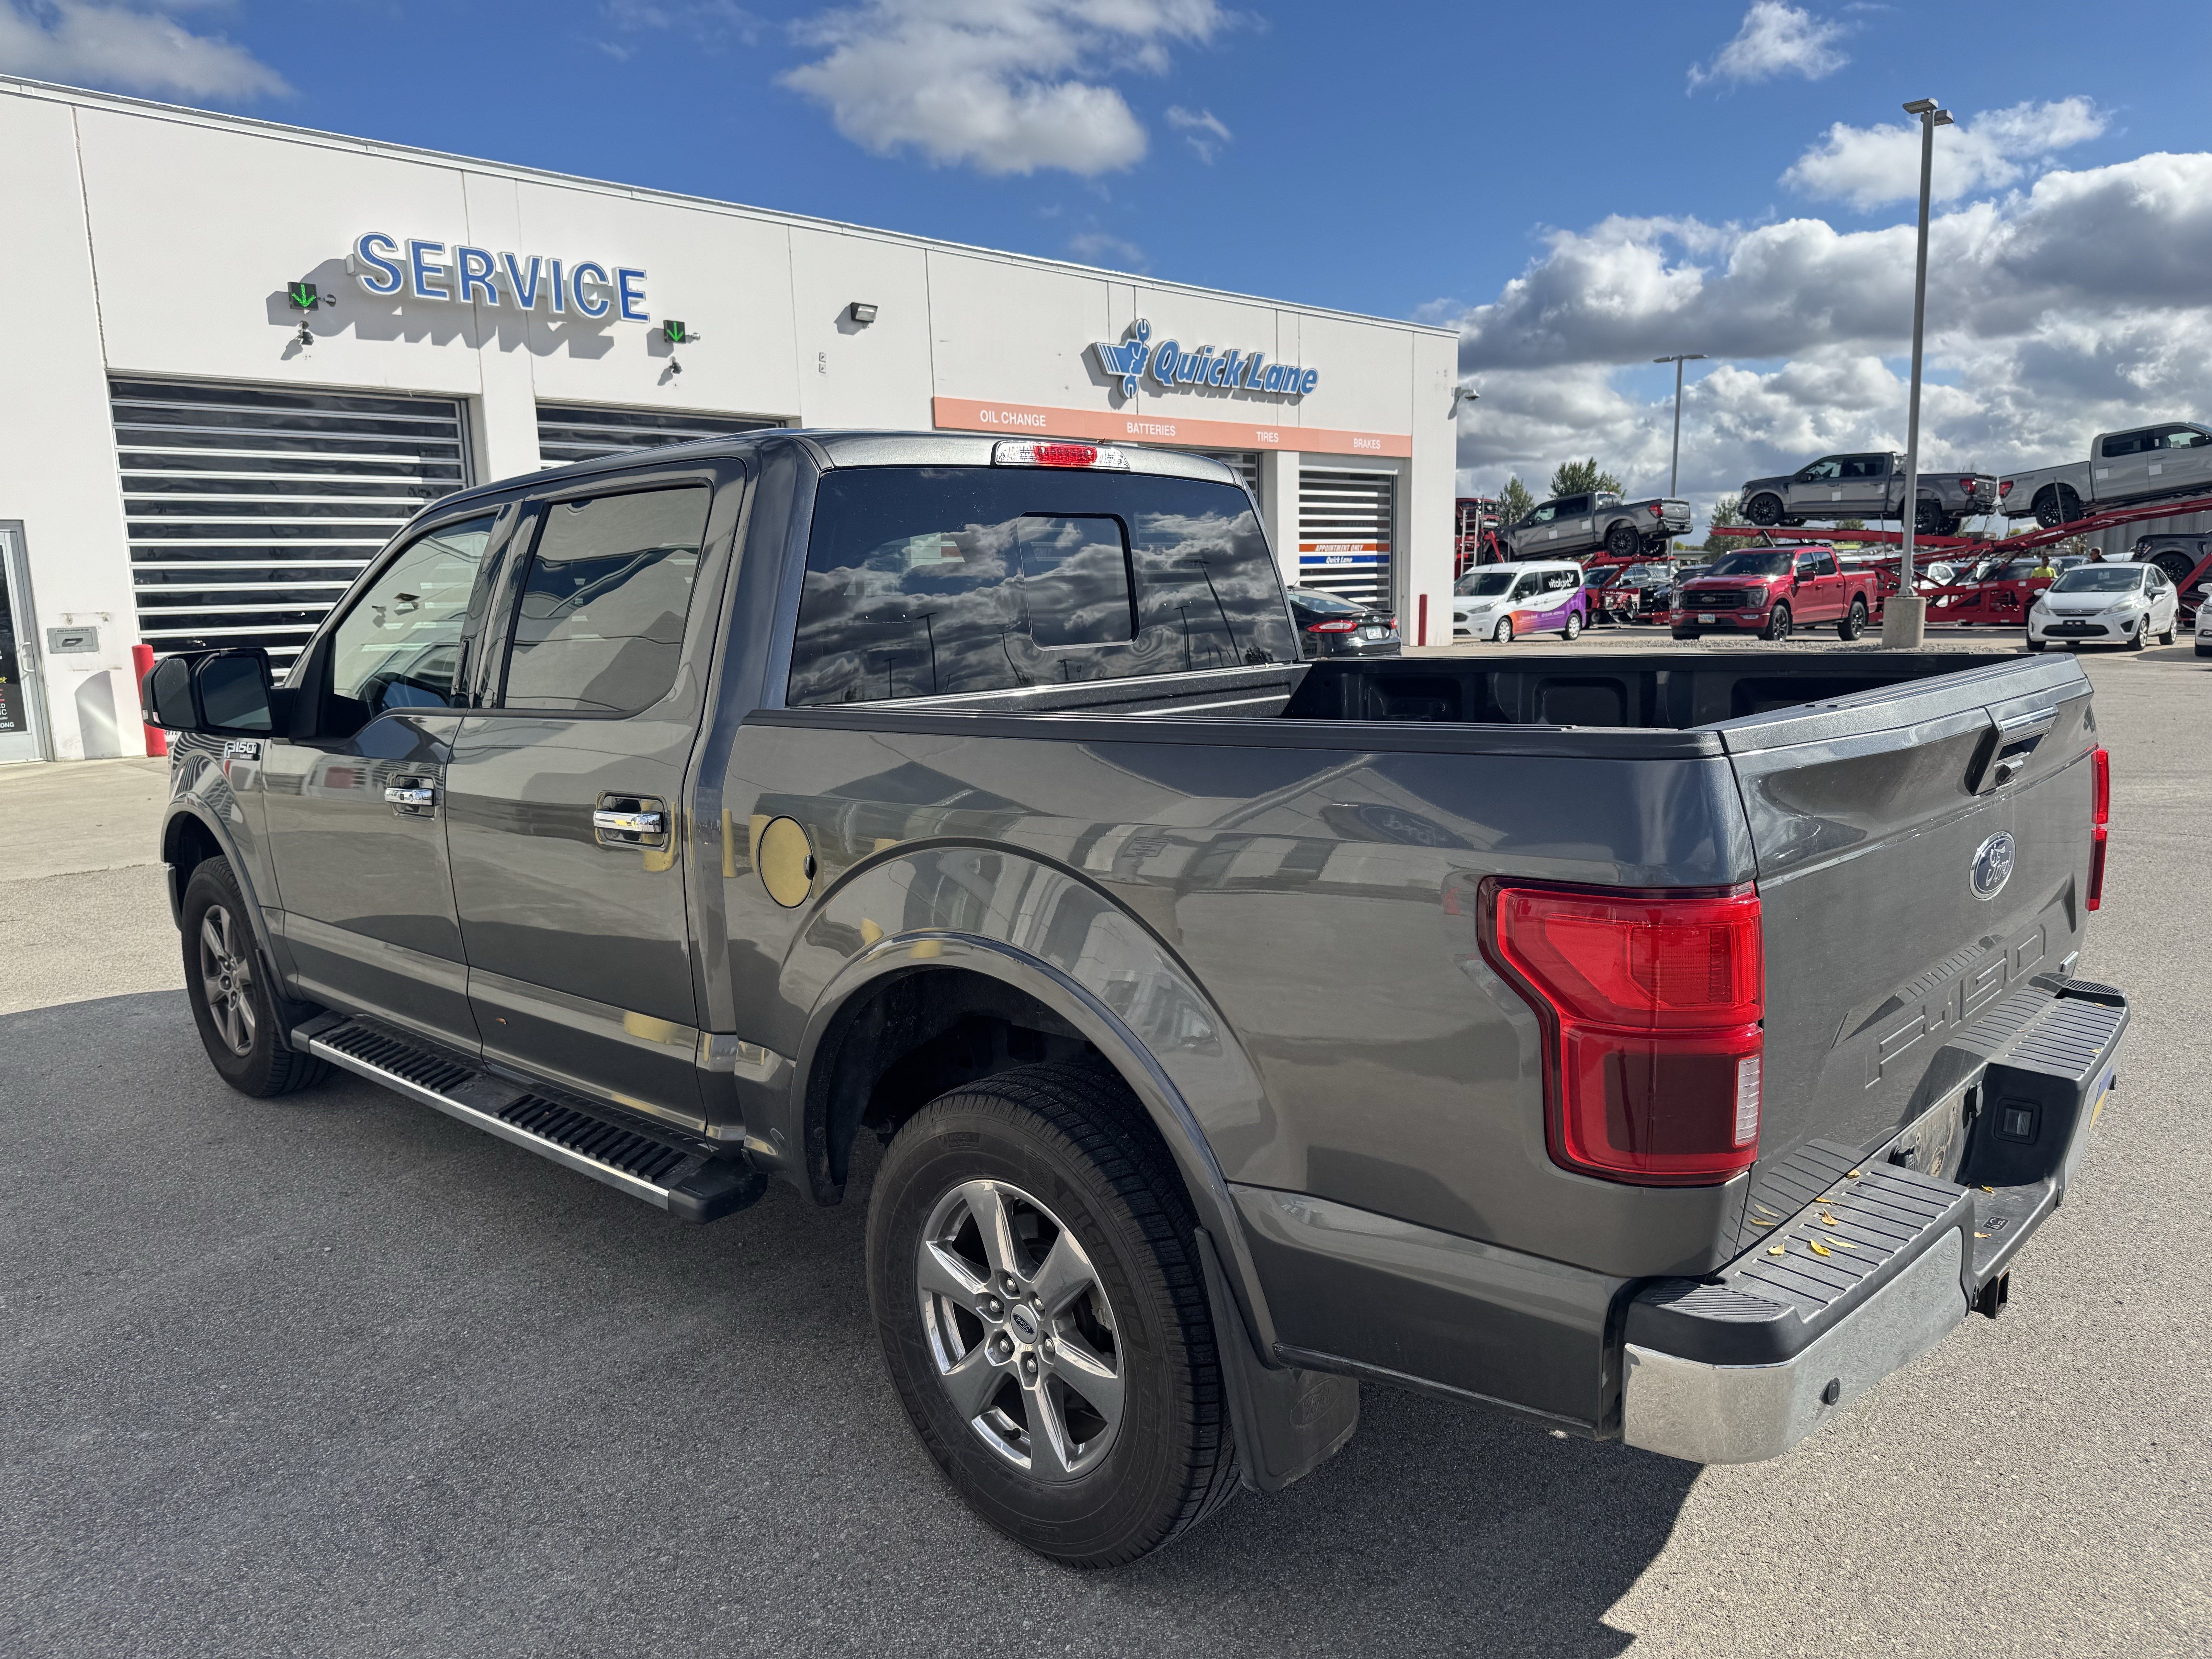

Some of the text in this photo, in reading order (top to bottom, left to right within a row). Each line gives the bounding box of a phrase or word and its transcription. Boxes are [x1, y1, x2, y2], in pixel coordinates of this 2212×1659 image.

[355, 232, 650, 323] SERVICE
[1152, 339, 1319, 396] Quick Lane
[980, 409, 1046, 427] OIL CHANGE
[1127, 422, 1176, 436] BATTERIES
[1256, 431, 1279, 443] TIRES
[1353, 438, 1381, 450] BRAKES
[1326, 556, 1340, 564] Quick
[1548, 578, 1571, 588] vitalant
[1985, 843, 2011, 886] Ford
[1015, 1316, 1030, 1332] Ford
